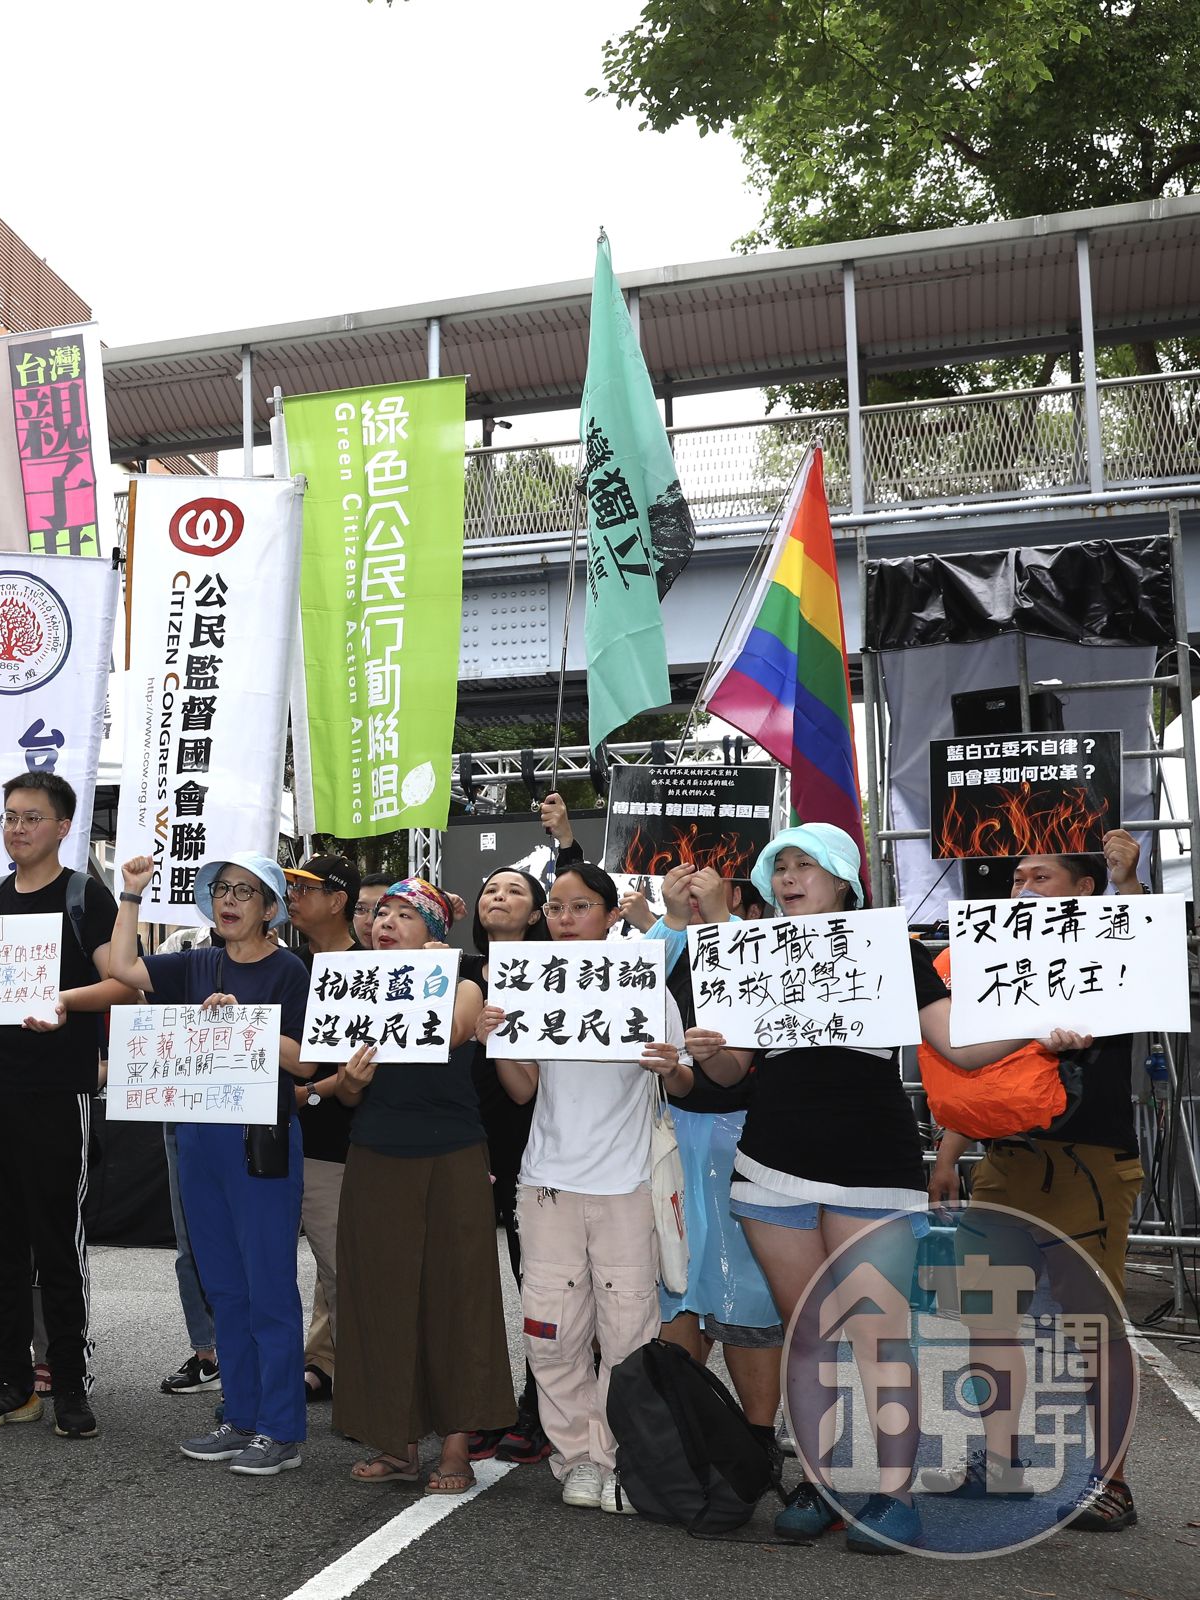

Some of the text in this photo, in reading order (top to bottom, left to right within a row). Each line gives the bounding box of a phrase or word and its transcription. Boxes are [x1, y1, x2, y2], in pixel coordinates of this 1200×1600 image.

[16, 345, 81, 386] 台灣
[334, 403, 356, 480] Green
[165, 571, 191, 665] CITIZEN
[346, 620, 357, 703] Action
[157, 672, 180, 800] CONGRESS
[168, 573, 229, 905] 公民監督國會聯盟
[947, 738, 1096, 762] 藍白立委不自律？
[350, 717, 362, 824] Alliance
[947, 764, 1096, 787] 國會要如何改革？
[314, 965, 449, 1004] 抗議藍白
[495, 955, 657, 994] 沒有討論
[127, 1024, 264, 1060] 我藐視國會
[308, 1010, 445, 1048] 沒收民主
[495, 1007, 657, 1046] 不是民主
